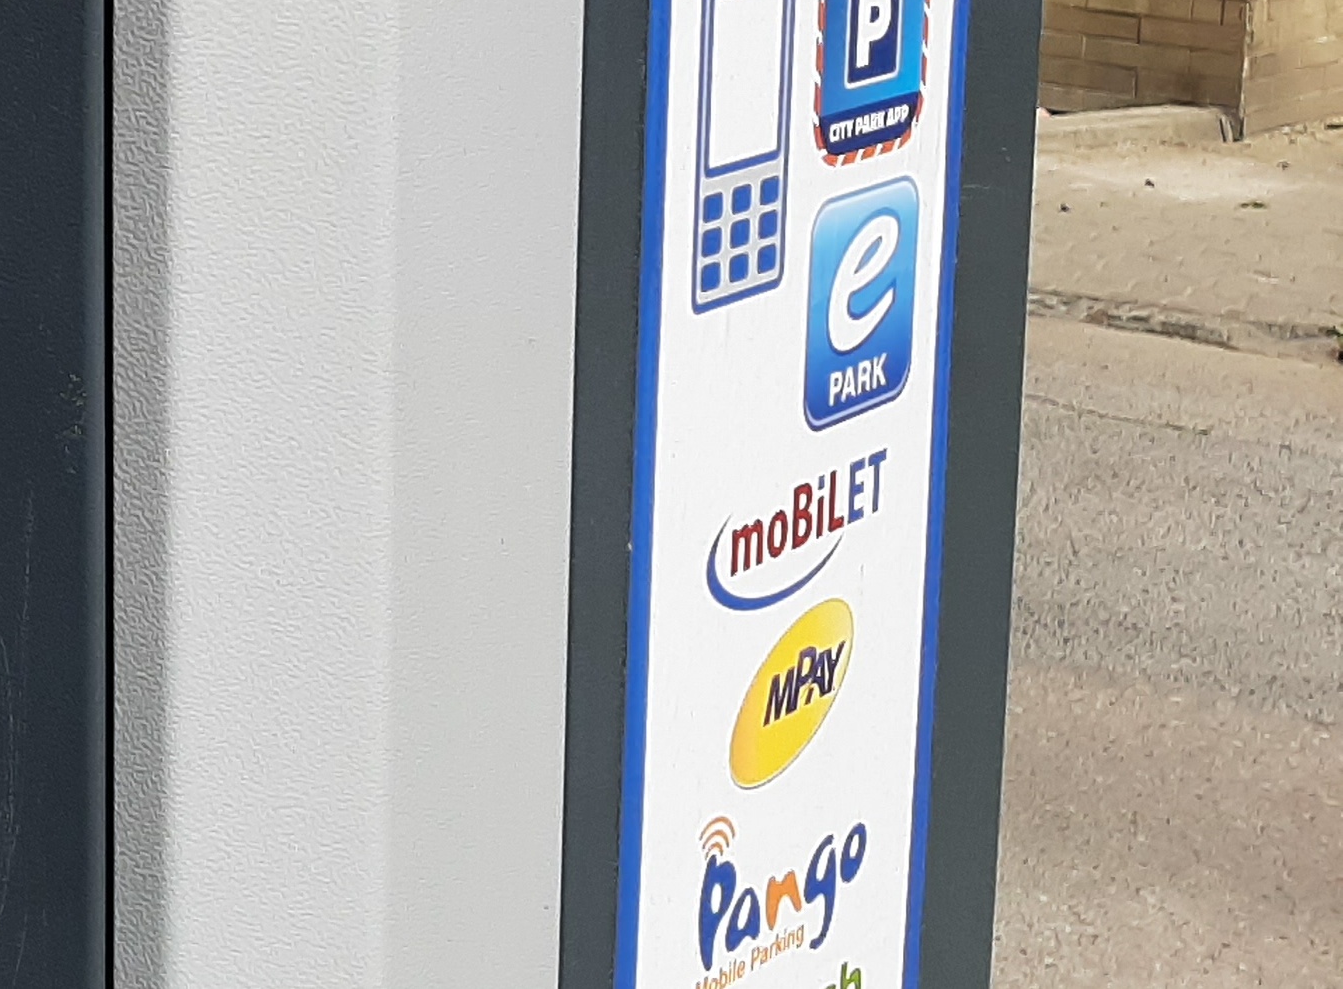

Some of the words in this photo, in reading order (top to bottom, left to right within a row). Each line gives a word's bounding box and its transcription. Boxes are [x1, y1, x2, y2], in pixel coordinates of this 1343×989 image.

[828, 118, 855, 143] CITY
[855, 111, 886, 136] PARK
[886, 104, 909, 126] APP
[827, 214, 900, 353] e
[828, 352, 888, 406] PARK
[730, 447, 888, 577] moBiLET
[698, 822, 868, 972] Pango
[750, 923, 805, 972] Parking
